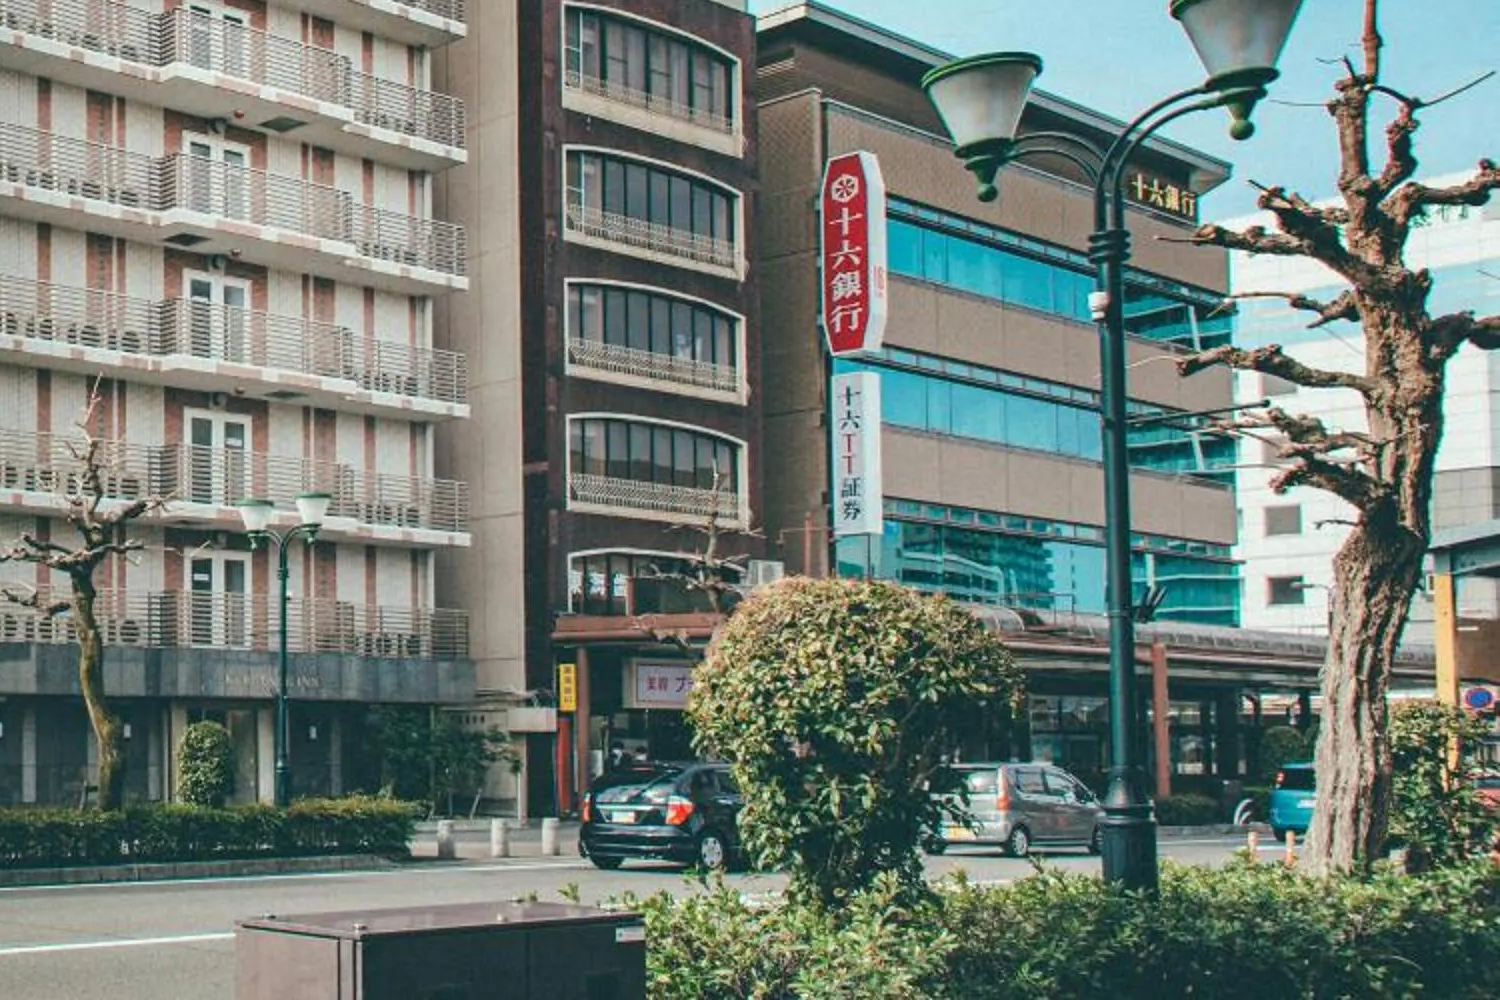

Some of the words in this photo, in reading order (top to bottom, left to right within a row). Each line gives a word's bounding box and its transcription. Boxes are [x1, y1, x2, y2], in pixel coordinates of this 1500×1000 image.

[1131, 173, 1196, 217] 十六銀行
[829, 207, 863, 333] 十六銀行
[838, 385, 861, 521] 十六TT証券
